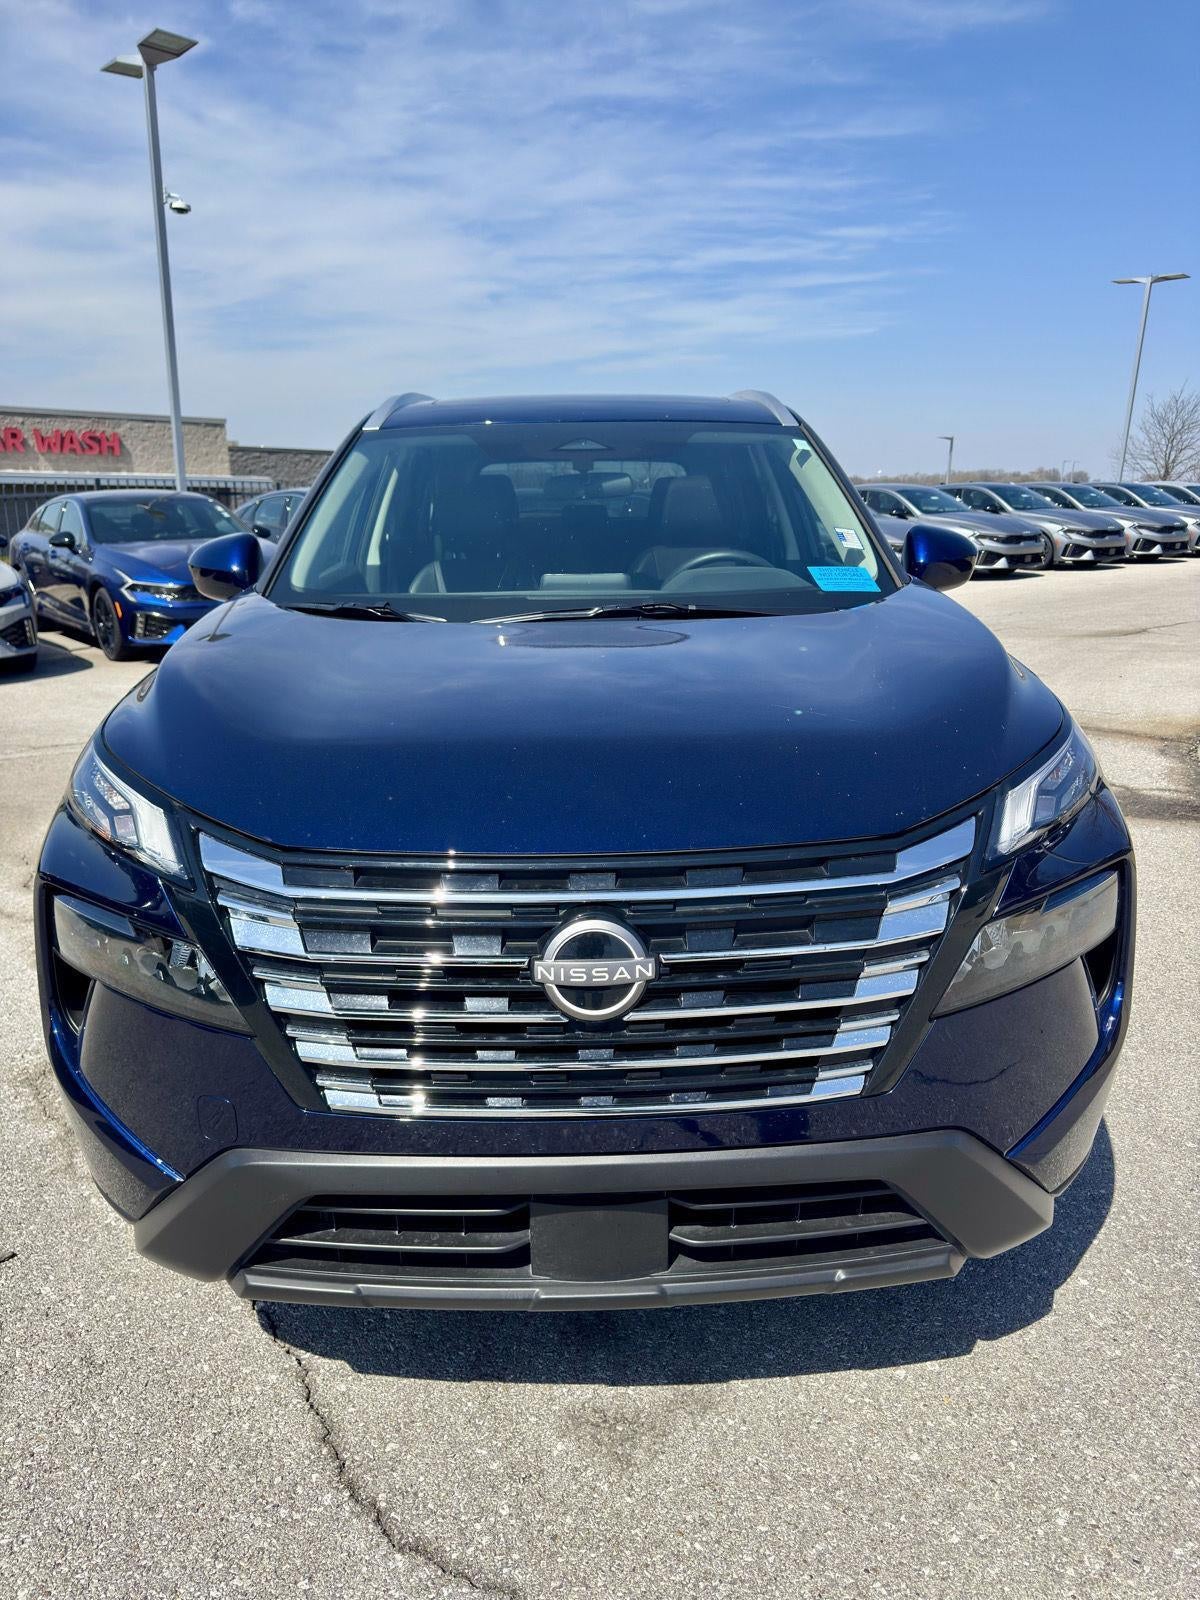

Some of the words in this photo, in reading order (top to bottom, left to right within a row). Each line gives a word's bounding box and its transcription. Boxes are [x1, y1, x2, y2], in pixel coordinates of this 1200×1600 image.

[0, 427, 25, 453] R
[32, 428, 121, 456] WASH
[537, 963, 653, 982] NISSAN
